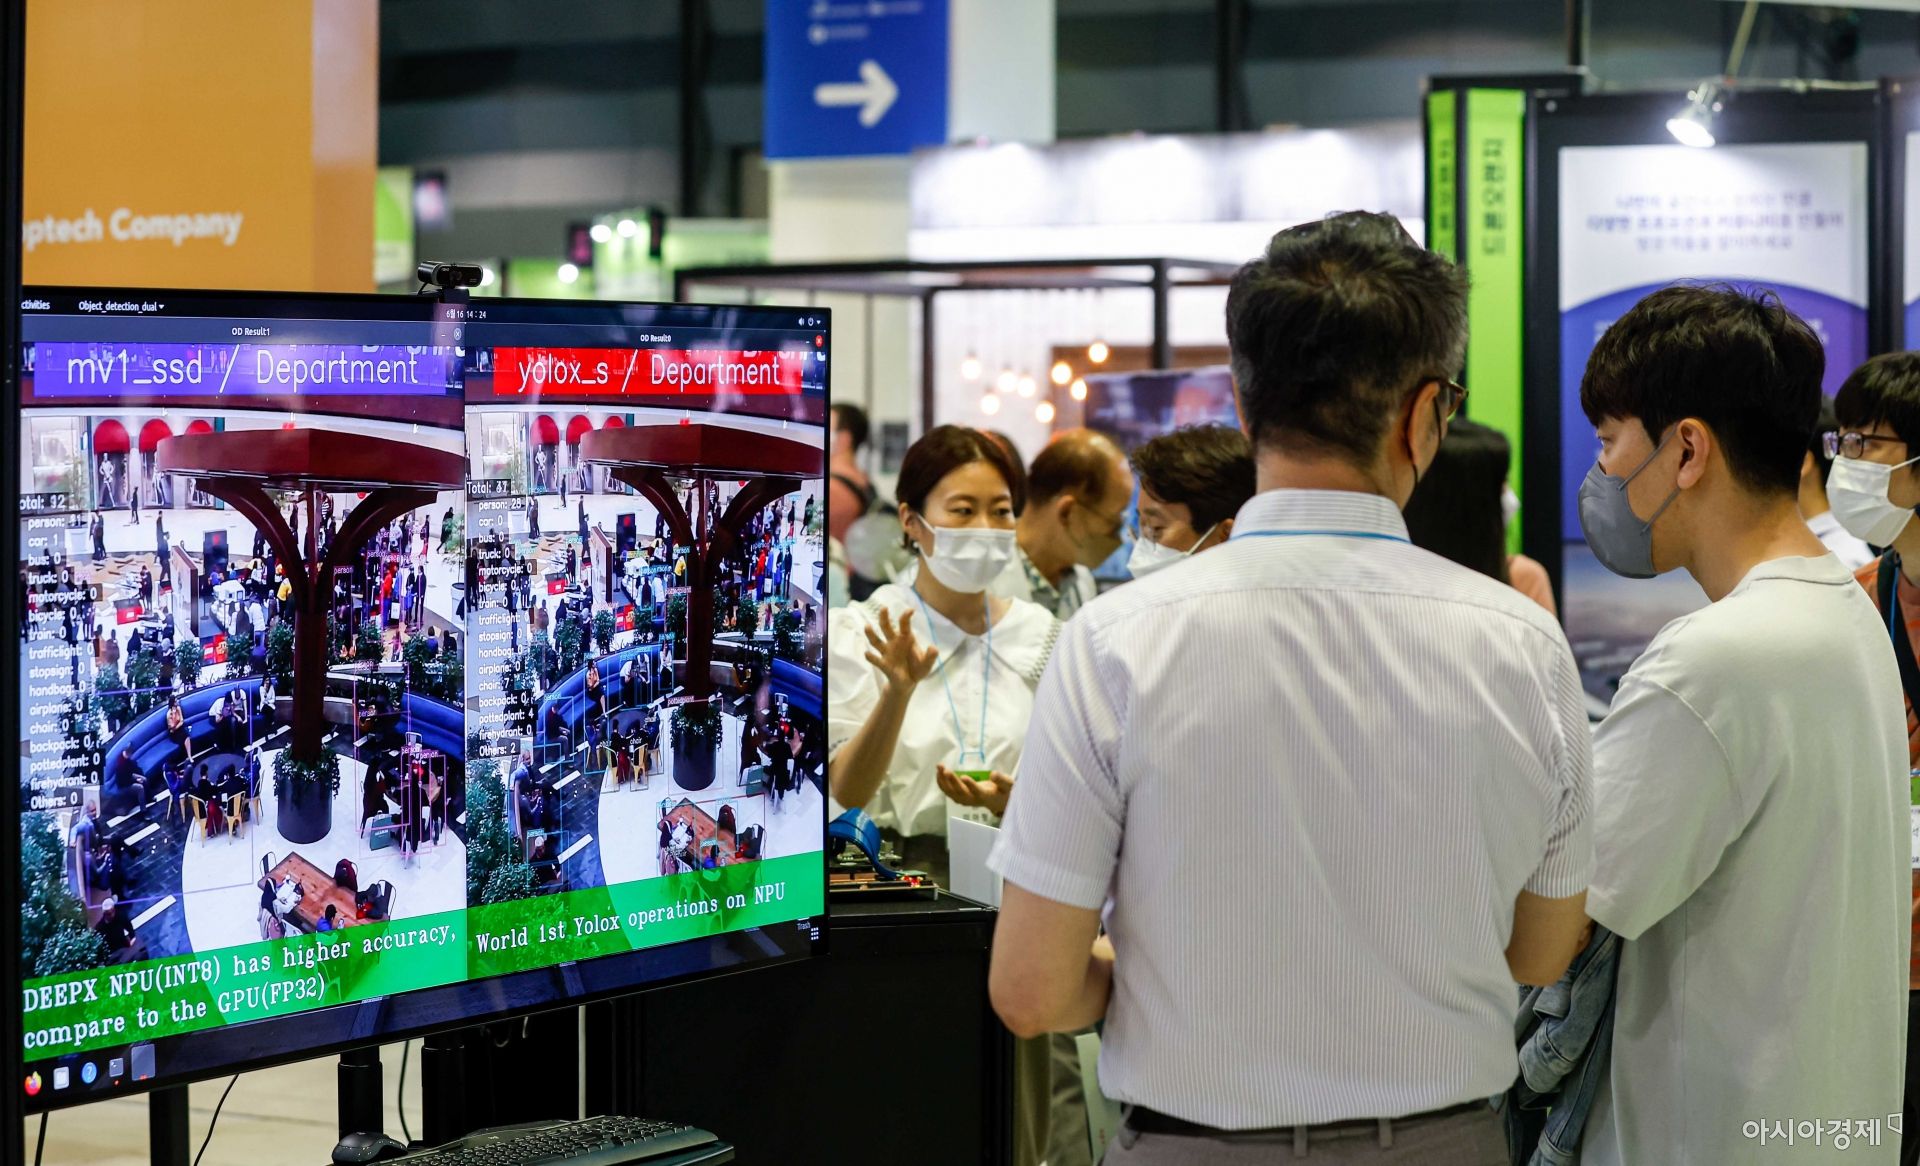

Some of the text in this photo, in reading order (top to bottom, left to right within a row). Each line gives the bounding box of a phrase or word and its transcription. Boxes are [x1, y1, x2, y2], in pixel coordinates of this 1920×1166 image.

[23, 207, 244, 252] ptech Company
[21, 300, 157, 314] ctivities Object_detection_dual
[457, 310, 464, 319] 16
[231, 327, 243, 336] OD
[640, 334, 650, 342] OD
[67, 344, 418, 393] mv1_ssd / Department
[518, 349, 780, 393] yolox_s / Department
[466, 480, 492, 495] Total:
[20, 495, 45, 510] otal:
[478, 501, 508, 513] person:
[28, 517, 65, 531] person:
[478, 515, 503, 527] car: 0
[28, 537, 48, 547] car:
[478, 531, 504, 543] bus: 0
[28, 552, 61, 566] bus: 0
[478, 547, 502, 560] truck:
[504, 546, 510, 559] 0
[478, 561, 532, 577] motorcycle: 0
[28, 570, 69, 584] truck: 0
[89, 586, 97, 599] 0
[478, 579, 517, 594] bicycle: 0
[479, 596, 508, 609] train: 0
[28, 606, 77, 624] bicycle: 0
[28, 625, 67, 641] train: 0
[478, 627, 523, 644] stopsign: 0
[86, 643, 94, 655] 0
[478, 643, 523, 658] handbag: 0
[29, 662, 85, 679] stopsign: 0
[478, 660, 521, 676] airplane: 0
[29, 680, 86, 697] handbag: 0
[478, 677, 510, 691] chair: 7
[75, 699, 83, 712] 0
[478, 693, 518, 708] backpack:
[520, 692, 526, 703] 0
[479, 707, 534, 726] pottedplant: 4
[30, 718, 69, 734] chair: 0
[479, 723, 532, 741] firehydrant: 0
[30, 735, 91, 754] backpack: 0
[479, 742, 516, 757] Others: 2
[30, 752, 100, 775] pottedplant: 0
[30, 771, 98, 792] firehydrant: 0
[30, 791, 78, 810] Others: 0
[476, 881, 786, 954] World 1st Yolox operations on NPU
[23, 925, 456, 1013] DEEPX NPU(INT8) has higher accuracy,
[23, 973, 325, 1049] compare to the GPU(FP32)
